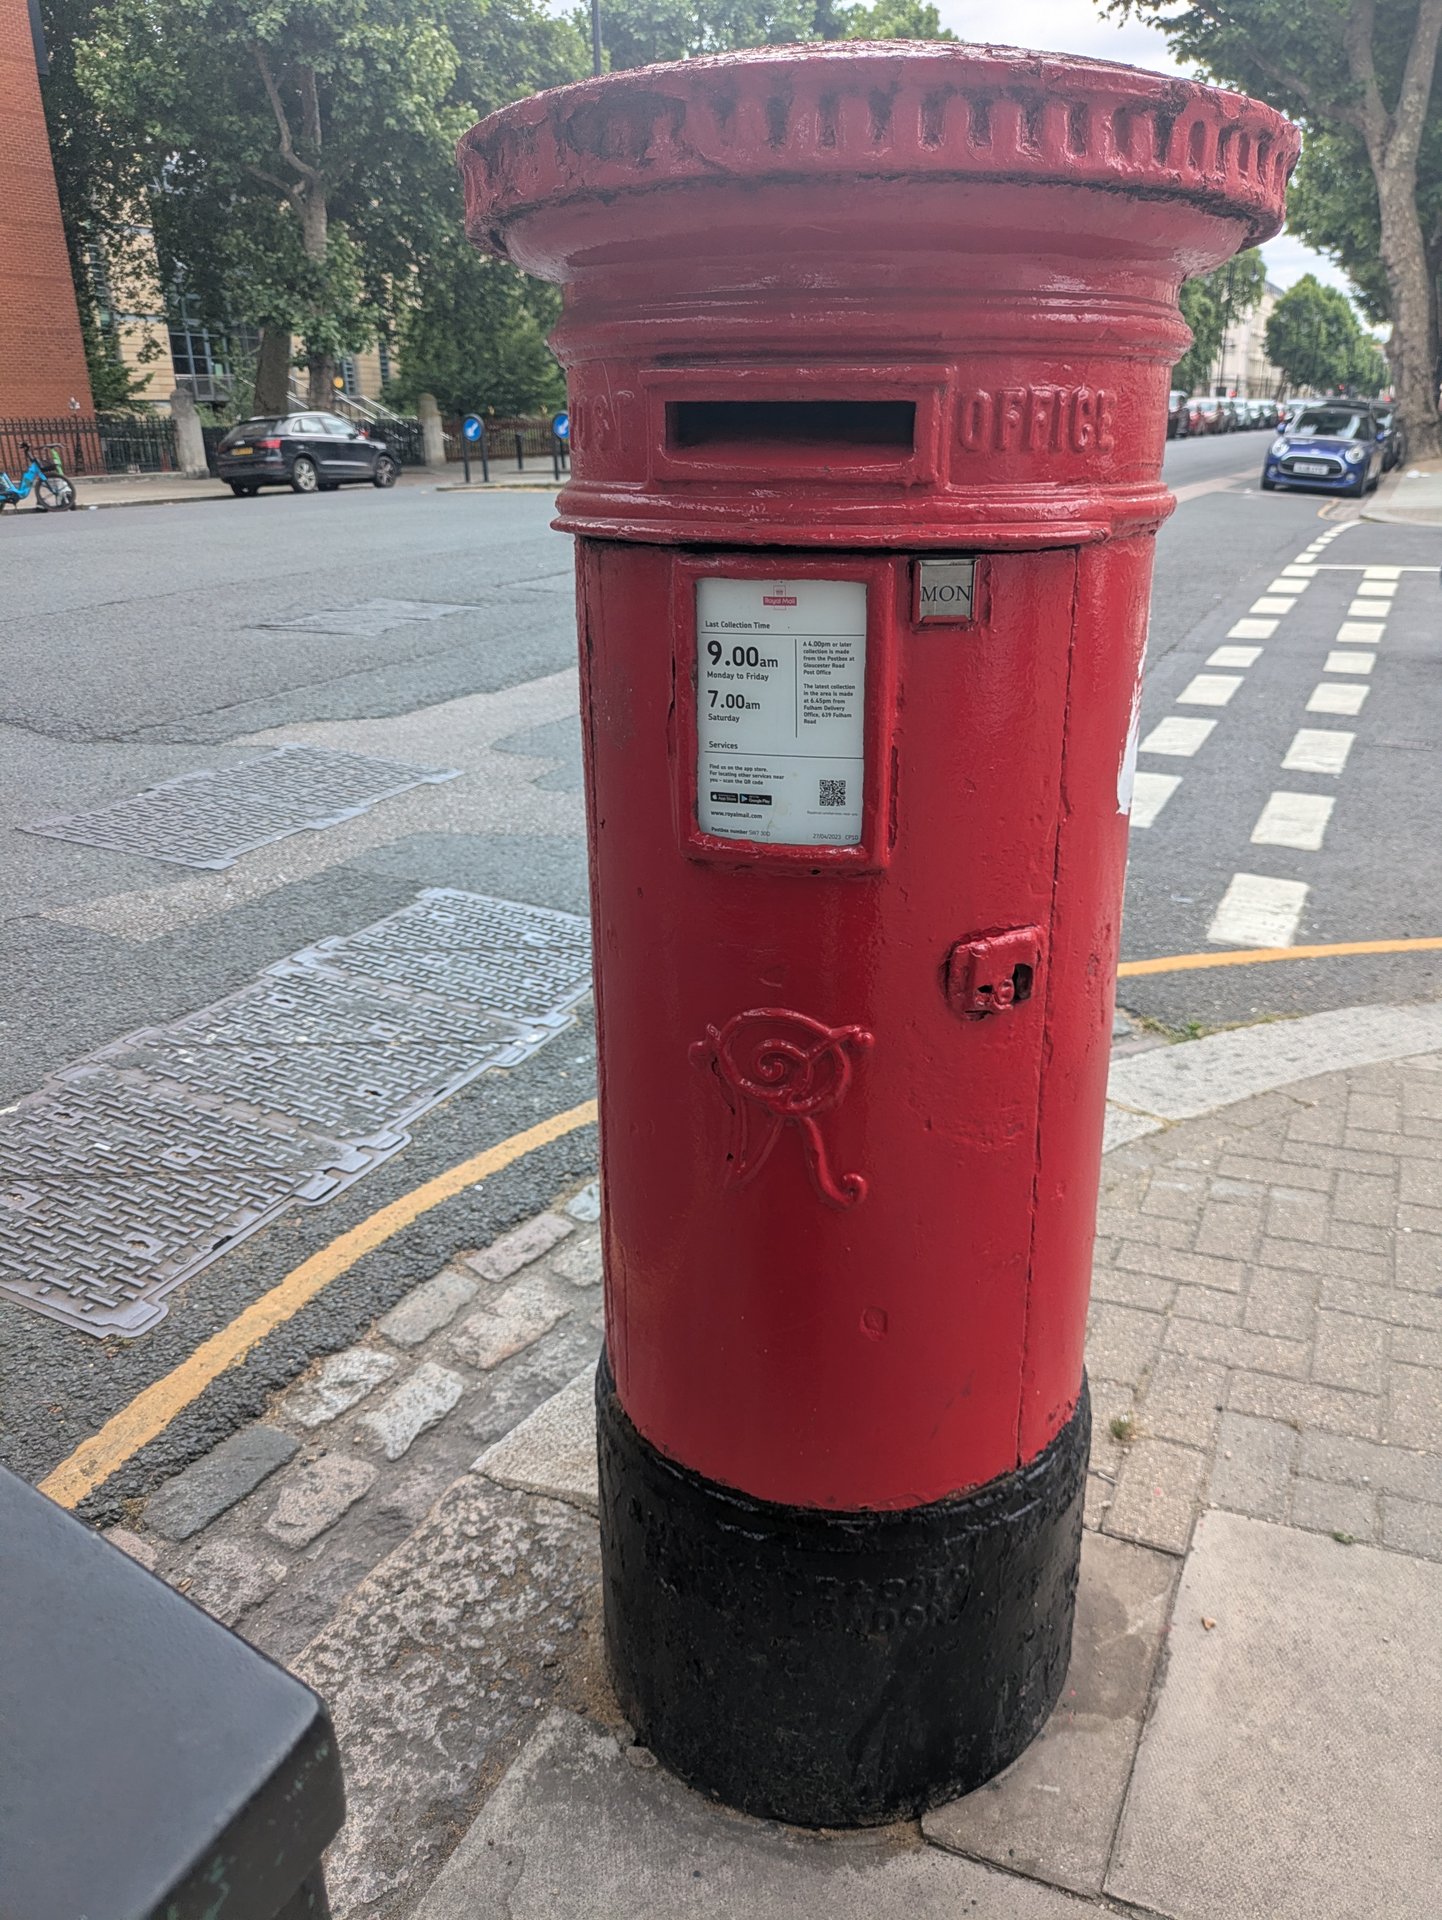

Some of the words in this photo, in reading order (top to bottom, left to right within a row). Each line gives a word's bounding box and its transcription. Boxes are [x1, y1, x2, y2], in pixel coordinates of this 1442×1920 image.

[957, 386, 1115, 454] OFFICE
[920, 585, 973, 602] MON
[721, 621, 752, 629] Collection
[707, 640, 778, 668] 9.00am
[707, 671, 735, 680] Monday
[746, 673, 769, 682] Friday
[708, 690, 761, 710] 7.00am
[708, 714, 740, 723] Saturday
[709, 741, 738, 749] Services
[711, 811, 762, 819] www.royalmail.com
